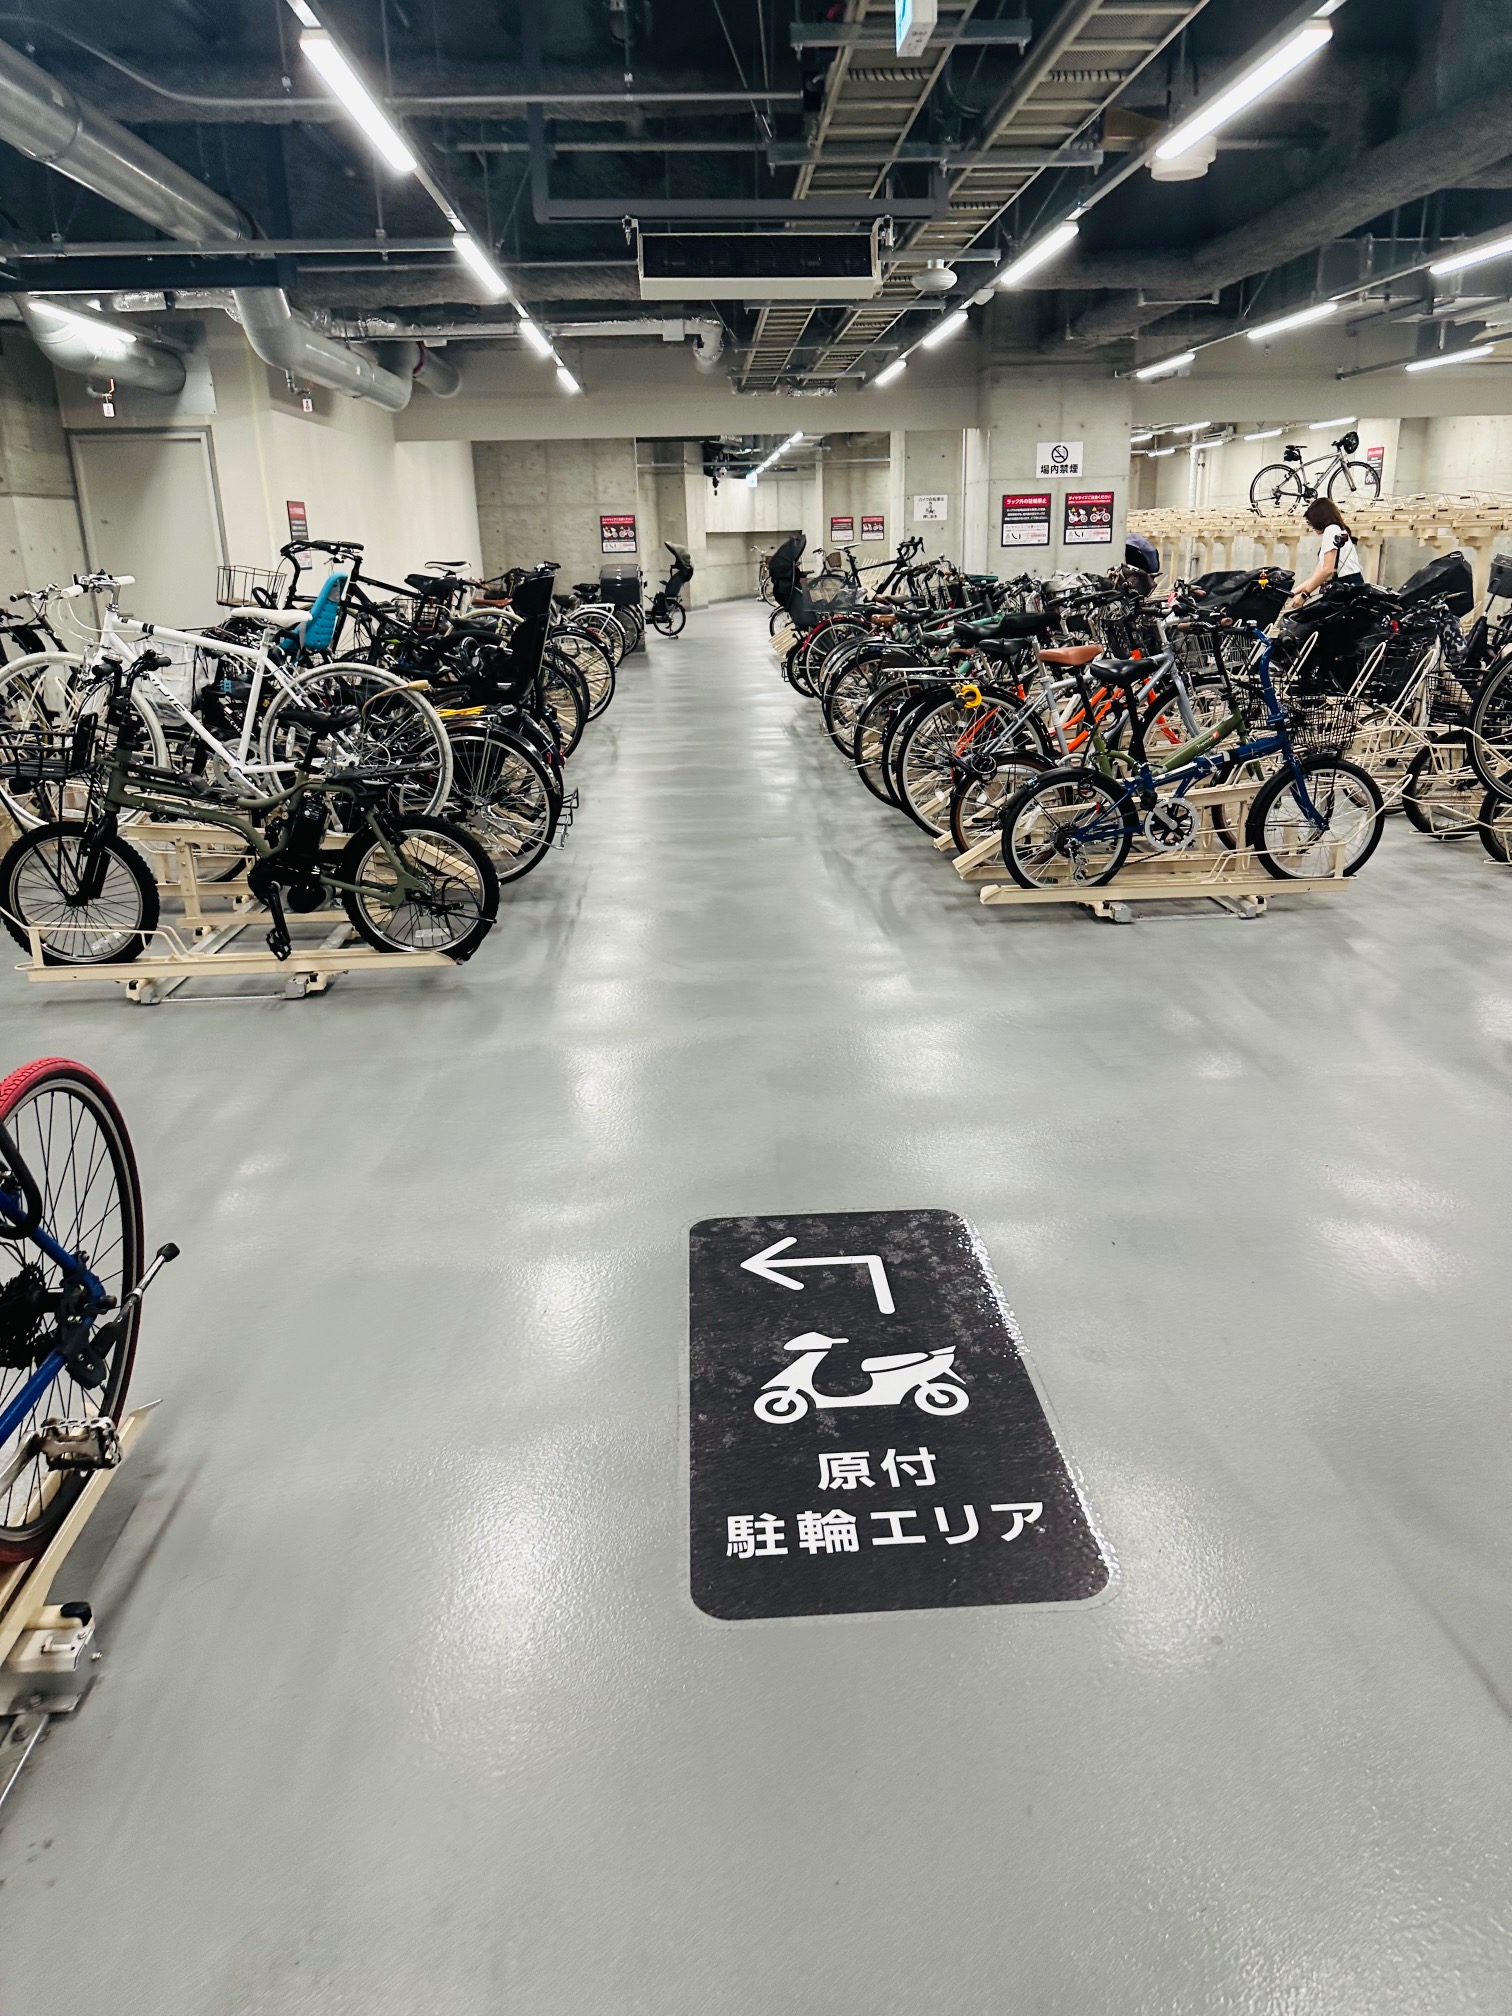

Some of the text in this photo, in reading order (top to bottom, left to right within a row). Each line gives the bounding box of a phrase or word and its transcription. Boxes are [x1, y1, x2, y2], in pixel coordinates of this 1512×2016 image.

[1041, 464, 1078, 474] 場内禁煙
[818, 1447, 936, 1491] 原付
[726, 1502, 1043, 1559] 駐輪エリア
